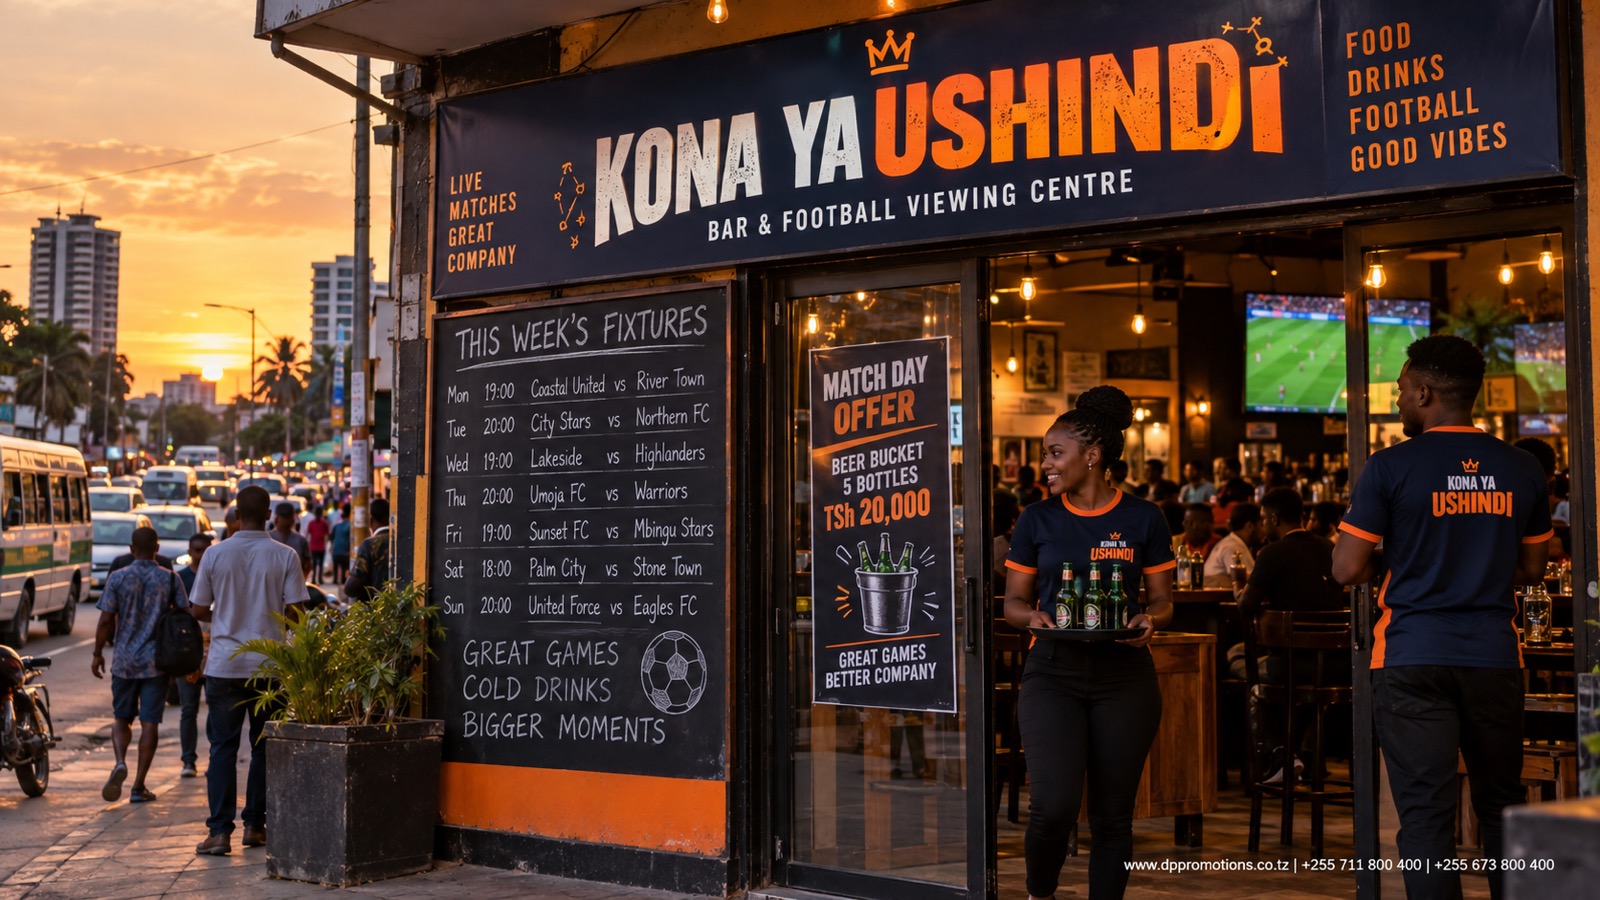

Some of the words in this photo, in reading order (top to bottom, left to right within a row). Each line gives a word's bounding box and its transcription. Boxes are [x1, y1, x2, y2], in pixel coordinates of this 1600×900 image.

[1346, 21, 1411, 59] FOOD
[1348, 53, 1444, 97] DRINKS
[1350, 87, 1479, 135] FOOTBALL
[594, 111, 764, 248] KONA
[782, 95, 864, 189] YA
[874, 37, 1284, 178] USHINDI
[1351, 136, 1417, 172] GOOD
[1430, 121, 1507, 159] VIBES
[450, 171, 482, 195] LIVE
[449, 191, 517, 221] MATCHES
[707, 216, 748, 242] BAR
[758, 213, 772, 236] &
[782, 198, 896, 233] FOOTBALL
[907, 183, 1017, 218] VIEWING
[1030, 168, 1134, 204] CENTRE
[448, 222, 494, 247] GREAT
[447, 244, 517, 273] COMPANY
[456, 326, 500, 360] THIS
[603, 304, 708, 344] FIXTURES
[448, 385, 469, 404] Mon
[485, 382, 515, 400] 19:00
[530, 377, 568, 398] Coastal
[572, 373, 605, 395] United
[614, 379, 626, 392] vs
[636, 371, 669, 390] River
[673, 367, 705, 388] Town
[823, 362, 887, 402] MATCH
[892, 355, 928, 388] DAY
[447, 419, 466, 438] Tue
[483, 417, 515, 435] 20:00
[530, 413, 554, 438] City
[559, 411, 591, 430] Stars
[608, 414, 620, 428] vs
[635, 407, 688, 427] Northern
[693, 403, 710, 423] FC
[833, 389, 916, 435] OFFER
[446, 453, 469, 473] Wed
[483, 452, 513, 470] 19:00
[530, 447, 583, 468] Lakeside
[607, 451, 620, 464] vs
[635, 441, 705, 470] Highlanders
[832, 453, 866, 476] BEER
[870, 441, 925, 468] BUCKET
[445, 488, 466, 507] Thu
[482, 487, 513, 505] 20:00
[530, 484, 564, 510] Umoja
[570, 482, 586, 503] FC
[605, 488, 619, 501] vs
[634, 480, 688, 501] Warriors
[843, 478, 852, 495] 5
[857, 465, 918, 494] BOTTLES
[1447, 475, 1478, 490] KONA
[1480, 475, 1496, 490] YA
[824, 502, 855, 532] TSh
[860, 488, 931, 526] 20,000
[1432, 491, 1513, 518] USHINDI
[445, 524, 462, 543] Fri
[482, 522, 512, 541] 19:00
[529, 520, 568, 541] Sunset
[573, 520, 589, 540] FC
[606, 525, 619, 539] vs
[634, 518, 677, 546] Mbingu
[681, 517, 714, 538] Stars
[444, 559, 464, 579] Sat
[482, 559, 512, 577] 18:00
[529, 557, 556, 577] Palm
[561, 557, 586, 584] City
[605, 563, 618, 576] vs
[633, 556, 667, 576] Stone
[671, 555, 702, 576] Town
[1090, 548, 1134, 563] USHINDI
[444, 595, 464, 615] Sun
[480, 596, 512, 614] 20:00
[528, 594, 565, 616] United
[570, 595, 600, 616] Force
[610, 601, 623, 615] vs
[633, 595, 674, 624] Eagles
[679, 595, 698, 616] FC
[463, 639, 535, 667] GREAT
[546, 640, 619, 667] GAMES
[839, 649, 878, 668] GREAT
[882, 643, 926, 664] GAMES
[463, 674, 521, 700] COLD
[535, 676, 612, 703] DRINKS
[826, 669, 871, 689] BETTER
[875, 662, 937, 684] COMPANY
[462, 710, 544, 739] BIGGER
[558, 714, 666, 745] MOMENTS
